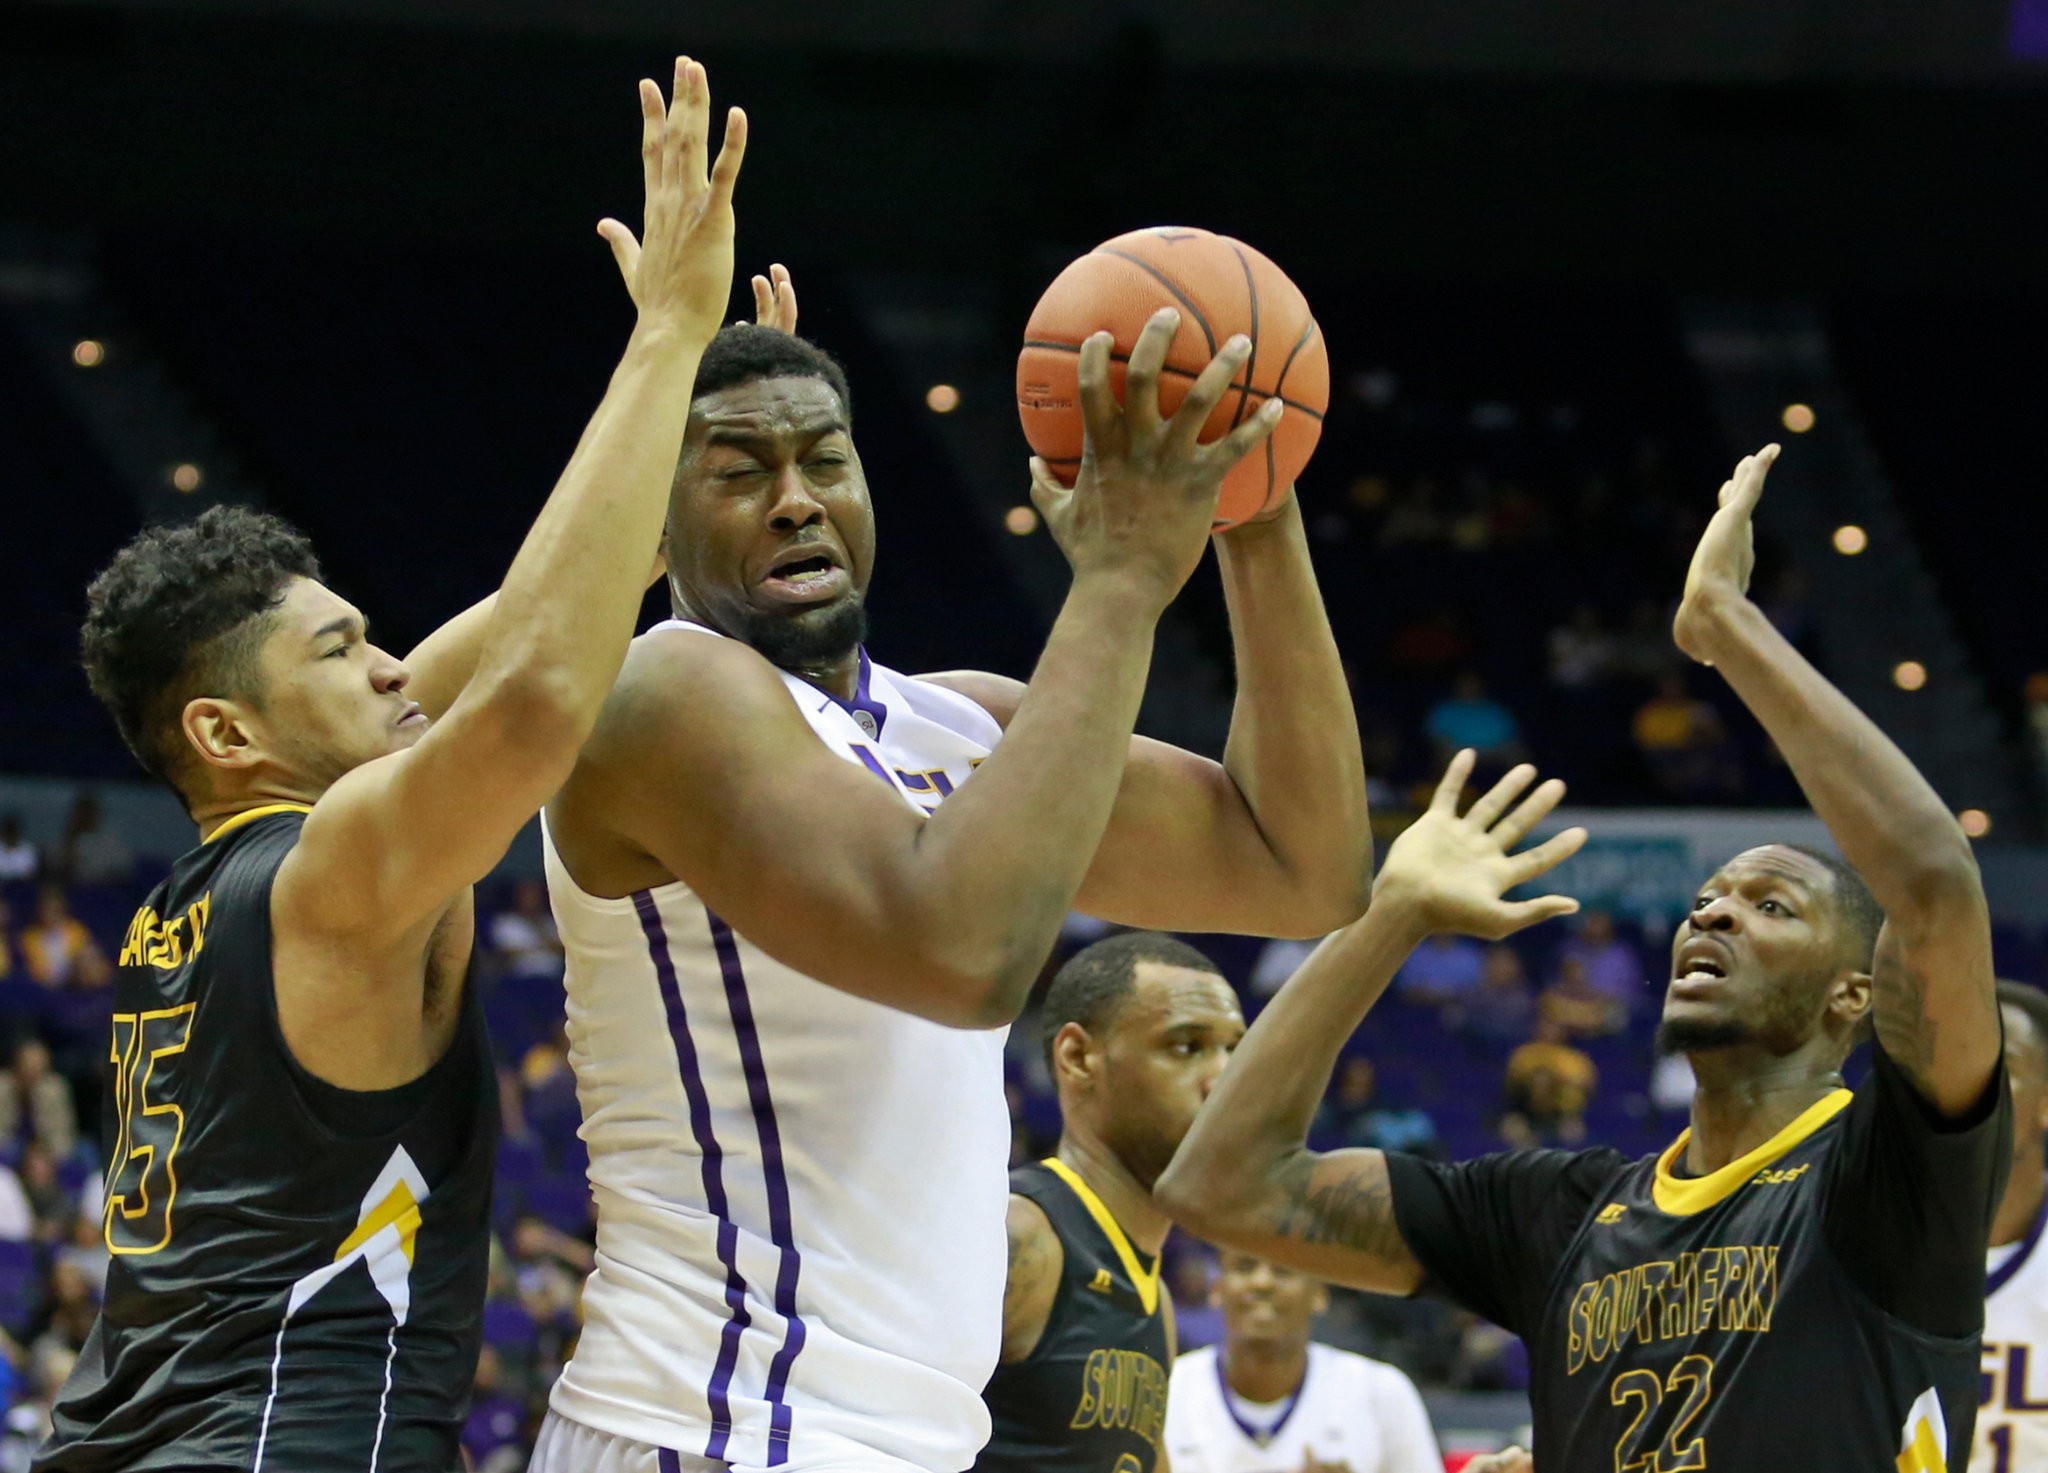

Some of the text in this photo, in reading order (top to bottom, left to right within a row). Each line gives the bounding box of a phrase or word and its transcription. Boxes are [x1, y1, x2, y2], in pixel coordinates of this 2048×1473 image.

[104, 1002, 197, 1255] 15
[1568, 1246, 1780, 1376] SOUTHERN
[1611, 1354, 1714, 1473] 22
